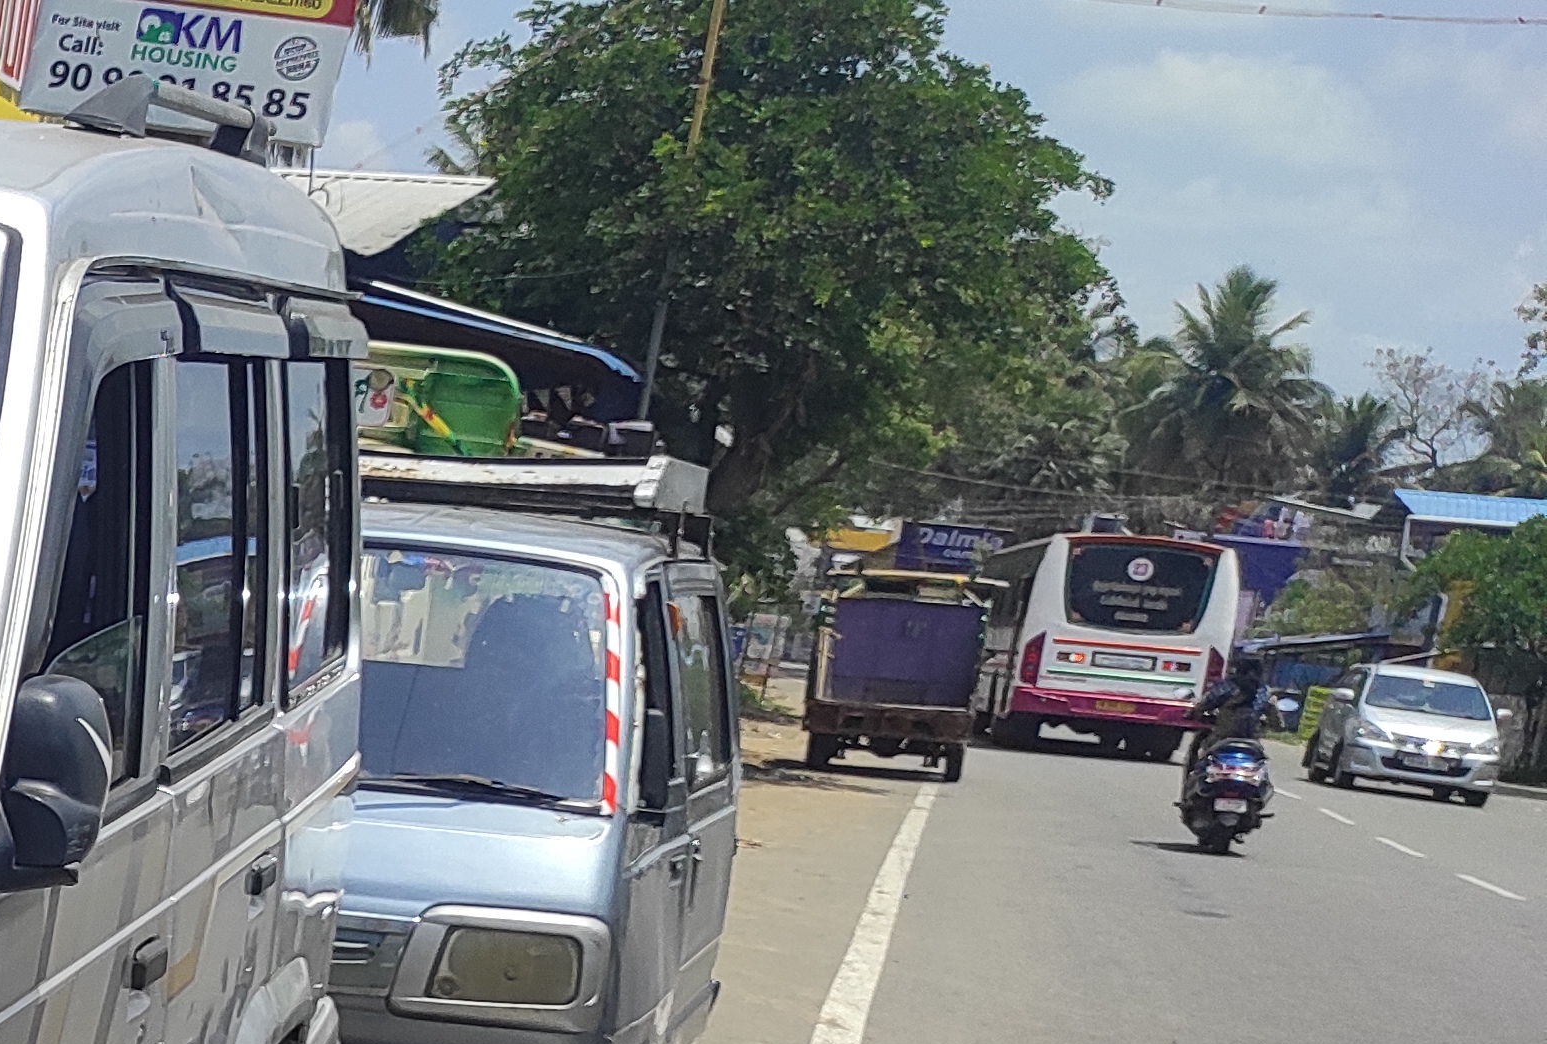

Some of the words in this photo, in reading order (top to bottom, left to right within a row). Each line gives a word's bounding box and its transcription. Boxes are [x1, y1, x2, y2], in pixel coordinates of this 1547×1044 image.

[58, 33, 105, 56] Call:
[130, 43, 239, 73] HOUSING
[48, 60, 93, 92] 90
[262, 88, 311, 120] 85
